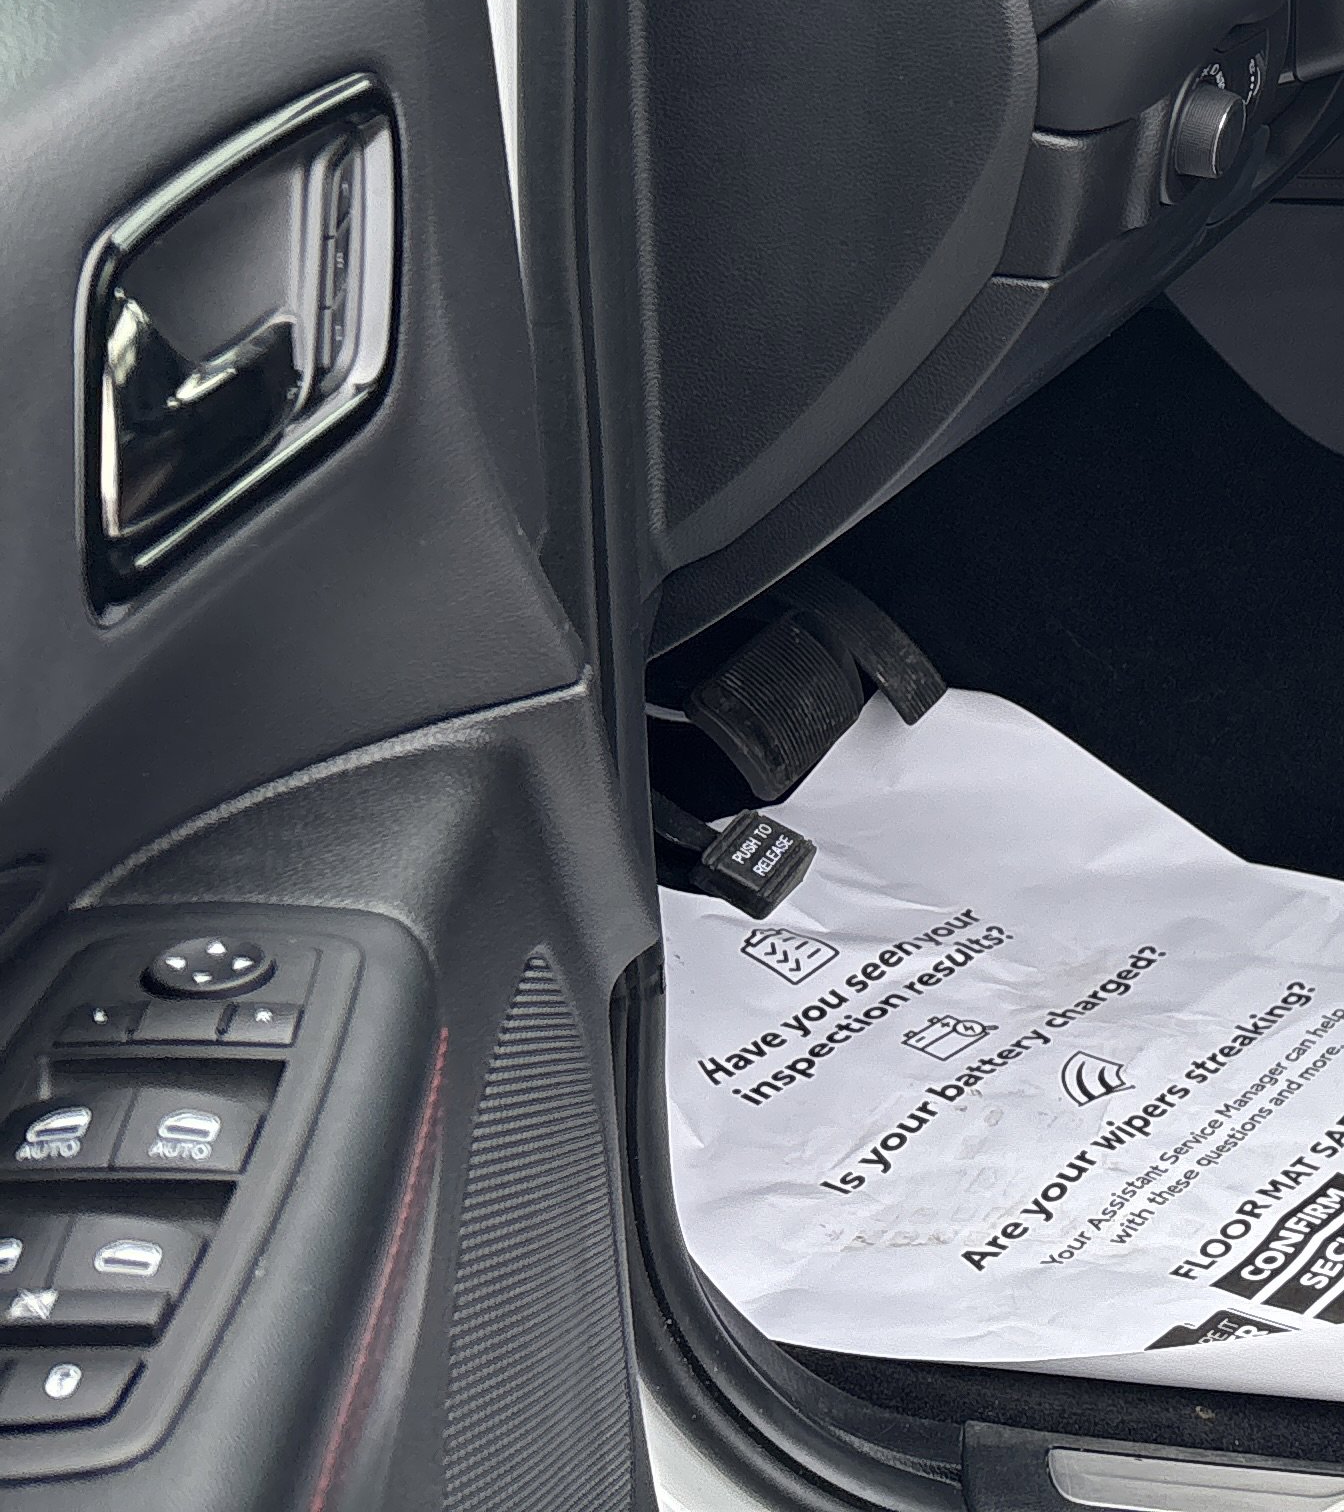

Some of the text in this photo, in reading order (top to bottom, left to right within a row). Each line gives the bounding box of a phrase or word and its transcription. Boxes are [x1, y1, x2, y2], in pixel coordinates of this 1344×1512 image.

[732, 823, 772, 864] PUSH TO
[752, 834, 794, 877] RELEASE
[697, 908, 980, 1085] Have you seen your
[732, 925, 1014, 1106] inspection results?
[820, 945, 1166, 1195] Is your battery charged?
[15, 1139, 81, 1161] AUTO
[148, 1140, 212, 1160] AUTO
[961, 981, 1316, 1272] Are your wipers streaking?
[1040, 1230, 1092, 1266] Your
[1087, 1165, 1169, 1231] Assistant
[1159, 1118, 1224, 1165] Service
[1215, 1062, 1288, 1118] Manager
[1285, 1038, 1317, 1063] can
[1110, 1209, 1155, 1245] with
[1147, 1169, 1200, 1206] these
[1196, 1105, 1274, 1166] questions
[1269, 1078, 1302, 1107] and
[1169, 1199, 1272, 1281] FLOOR
[1256, 1156, 1320, 1201] MAT
